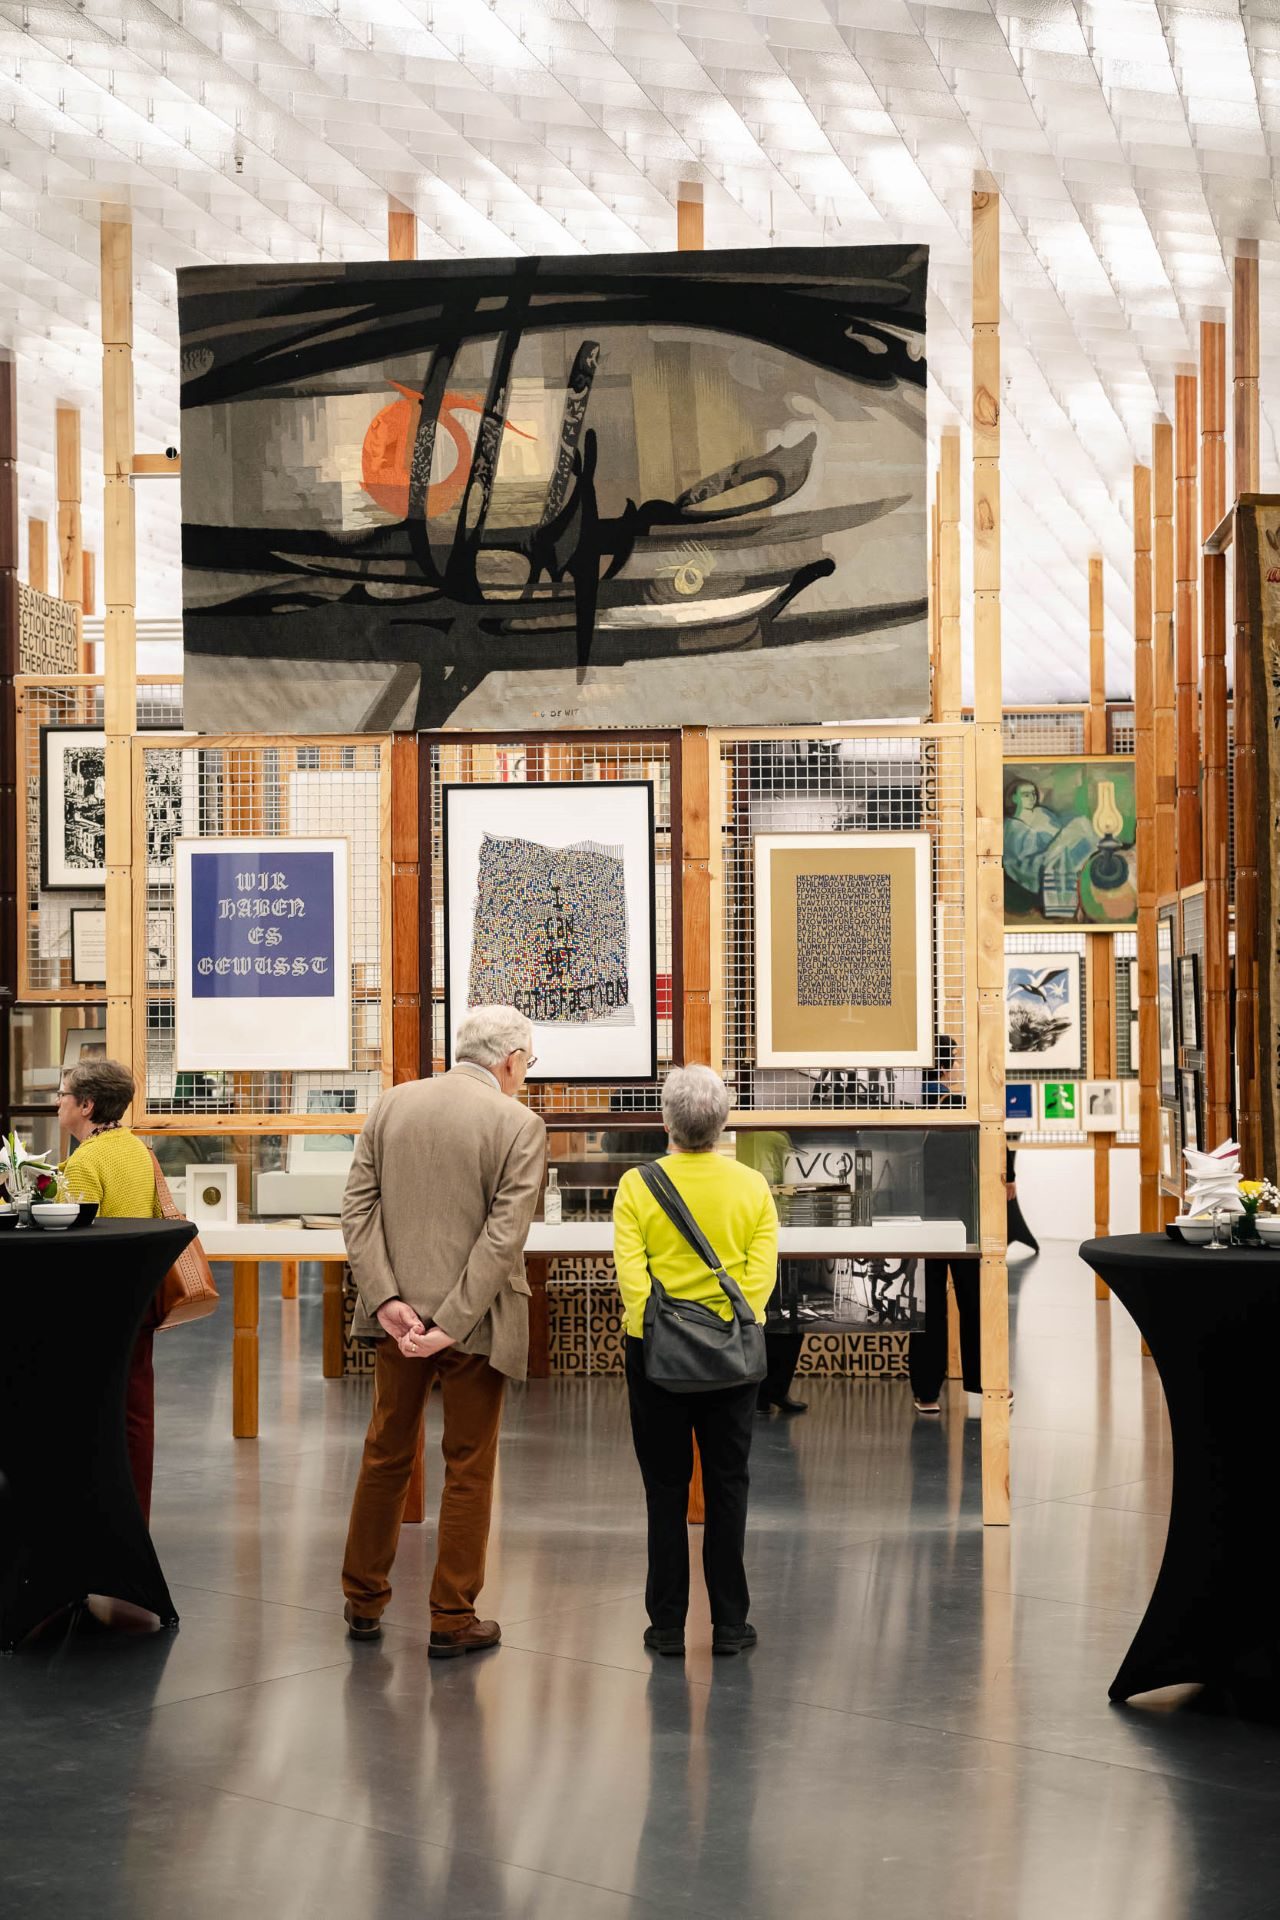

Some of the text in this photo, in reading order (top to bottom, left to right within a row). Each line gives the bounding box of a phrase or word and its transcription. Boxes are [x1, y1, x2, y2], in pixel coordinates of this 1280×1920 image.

[235, 872, 289, 892] WIR
[218, 898, 306, 920] HABEN
[247, 926, 283, 947] ES
[197, 956, 329, 976] GEWUSST
